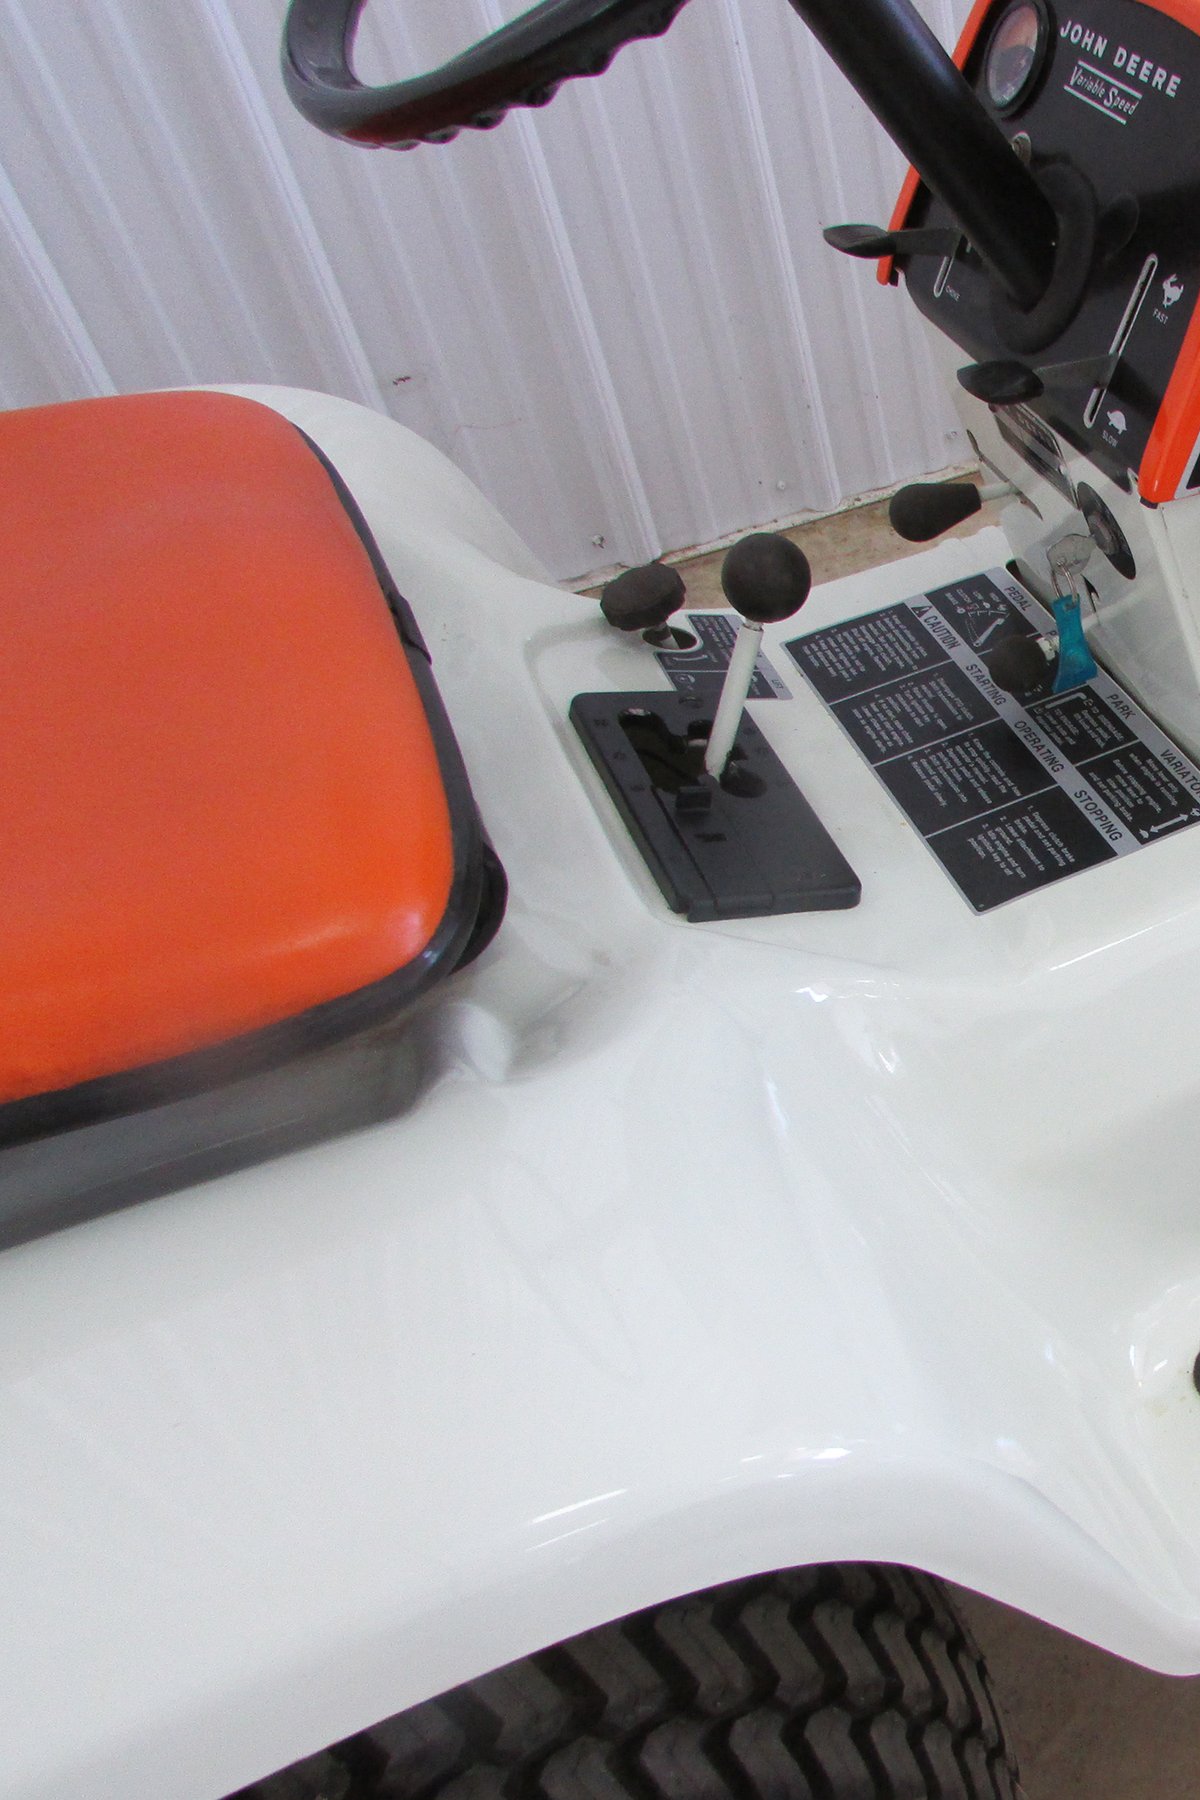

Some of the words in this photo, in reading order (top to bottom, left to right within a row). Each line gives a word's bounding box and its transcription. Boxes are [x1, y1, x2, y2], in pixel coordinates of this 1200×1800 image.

[1060, 20, 1108, 58] JOHN
[1113, 46, 1181, 98] DEERE
[1070, 66, 1106, 99] Variable
[1103, 84, 1139, 116] Speed
[1152, 308, 1169, 325] FAST
[1101, 429, 1119, 449] SLOW
[1004, 585, 1033, 611] PEDAL
[922, 614, 961, 650] CAUTION
[964, 663, 1008, 706] STARTING
[1105, 693, 1136, 719] PARK
[1012, 719, 1065, 773] OPERATING
[1072, 789, 1124, 841] STOPPING
